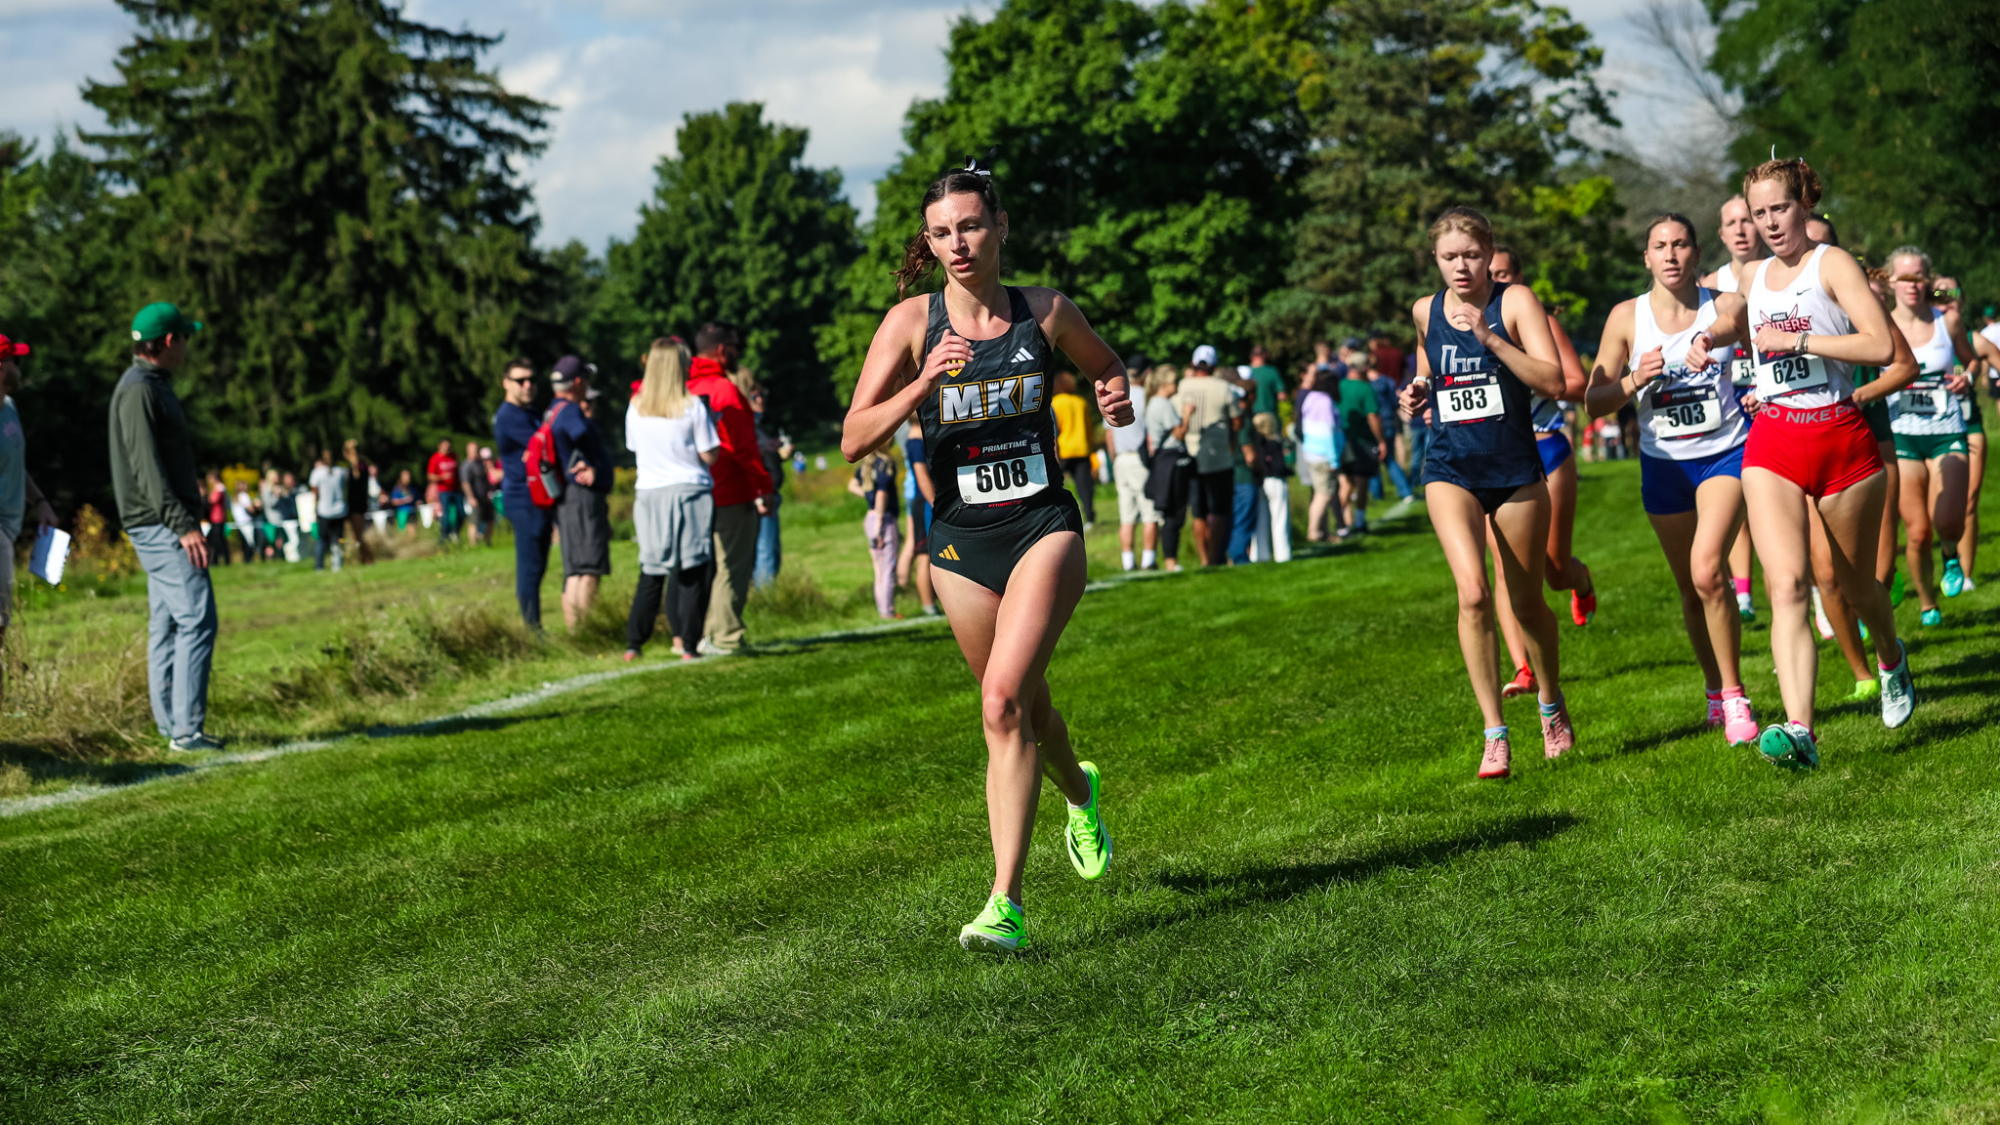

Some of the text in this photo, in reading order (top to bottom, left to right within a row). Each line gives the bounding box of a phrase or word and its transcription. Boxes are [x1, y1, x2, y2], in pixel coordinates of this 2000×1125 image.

[1772, 356, 1810, 384] 629
[940, 372, 1045, 424] MKE
[1450, 388, 1487, 412] 583
[1666, 402, 1706, 427] 503
[1786, 408, 1832, 424] NIKE
[982, 440, 1027, 453] PRIMETIME
[975, 459, 1029, 493] 608
